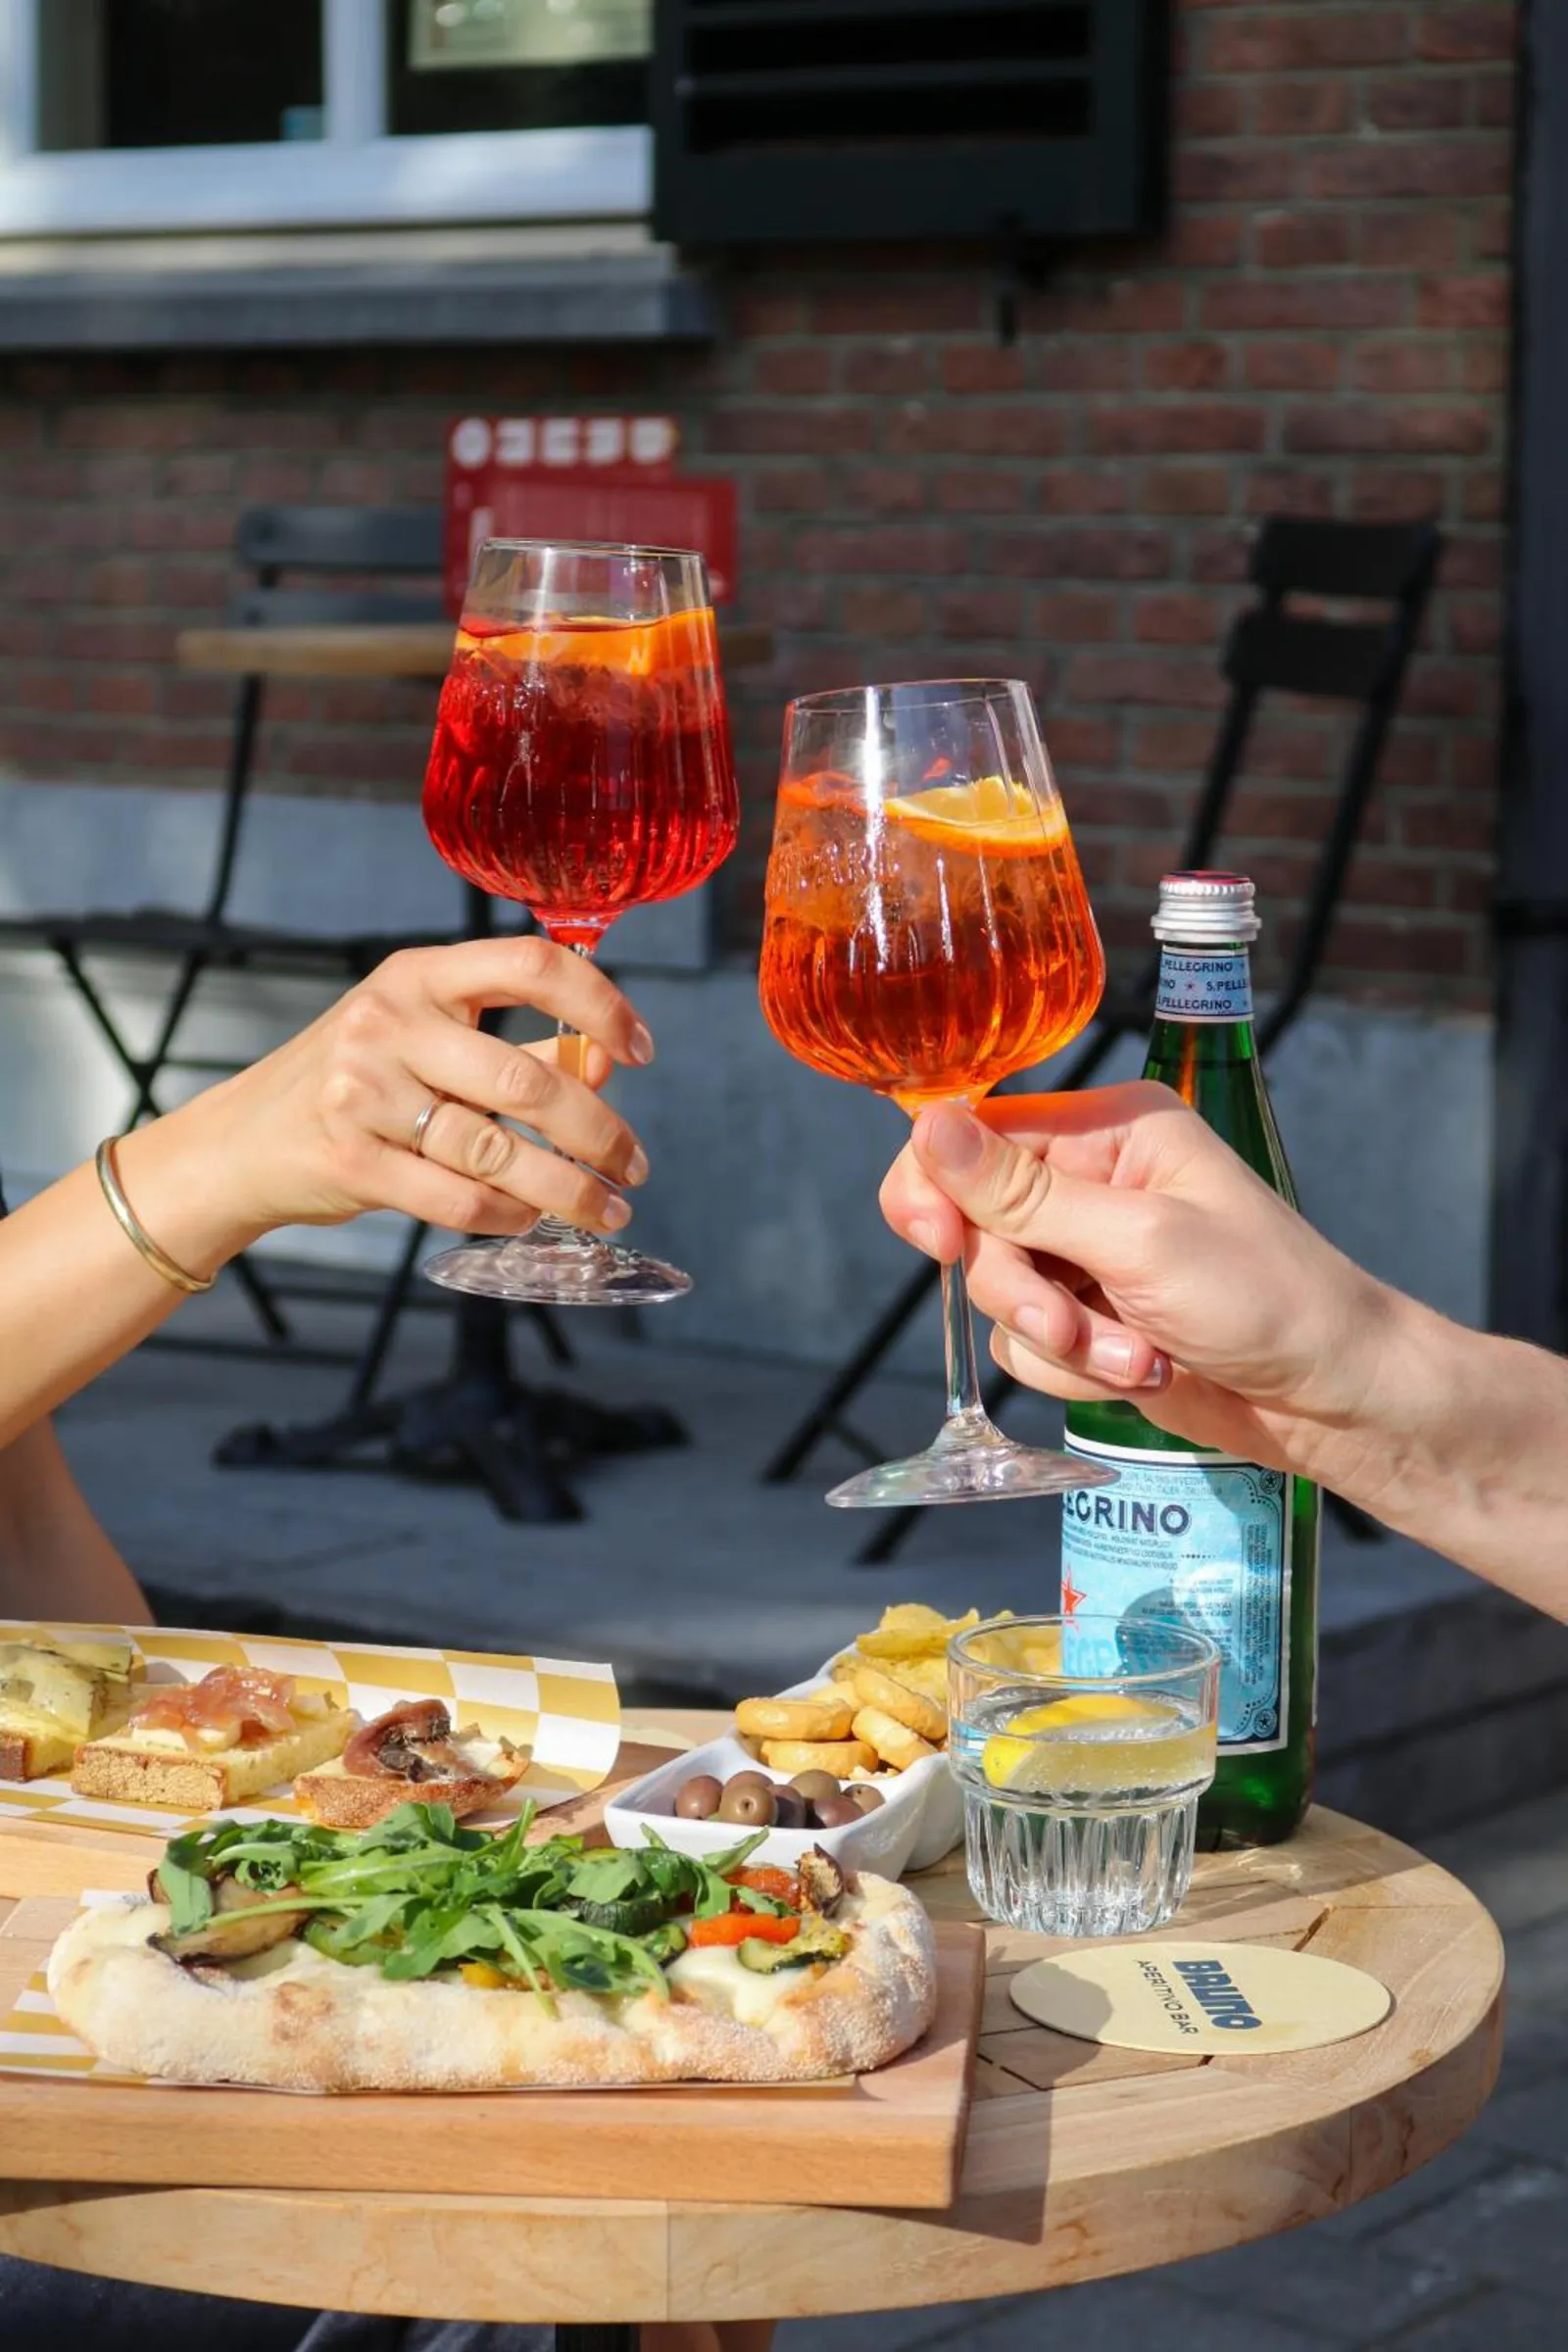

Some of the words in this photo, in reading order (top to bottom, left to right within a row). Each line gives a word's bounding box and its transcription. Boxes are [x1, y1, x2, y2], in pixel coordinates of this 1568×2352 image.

[1136, 1960, 1183, 2011] APERITIVO
[1170, 2014, 1199, 2034] BAR
[1172, 1960, 1262, 2030] BRUNO
